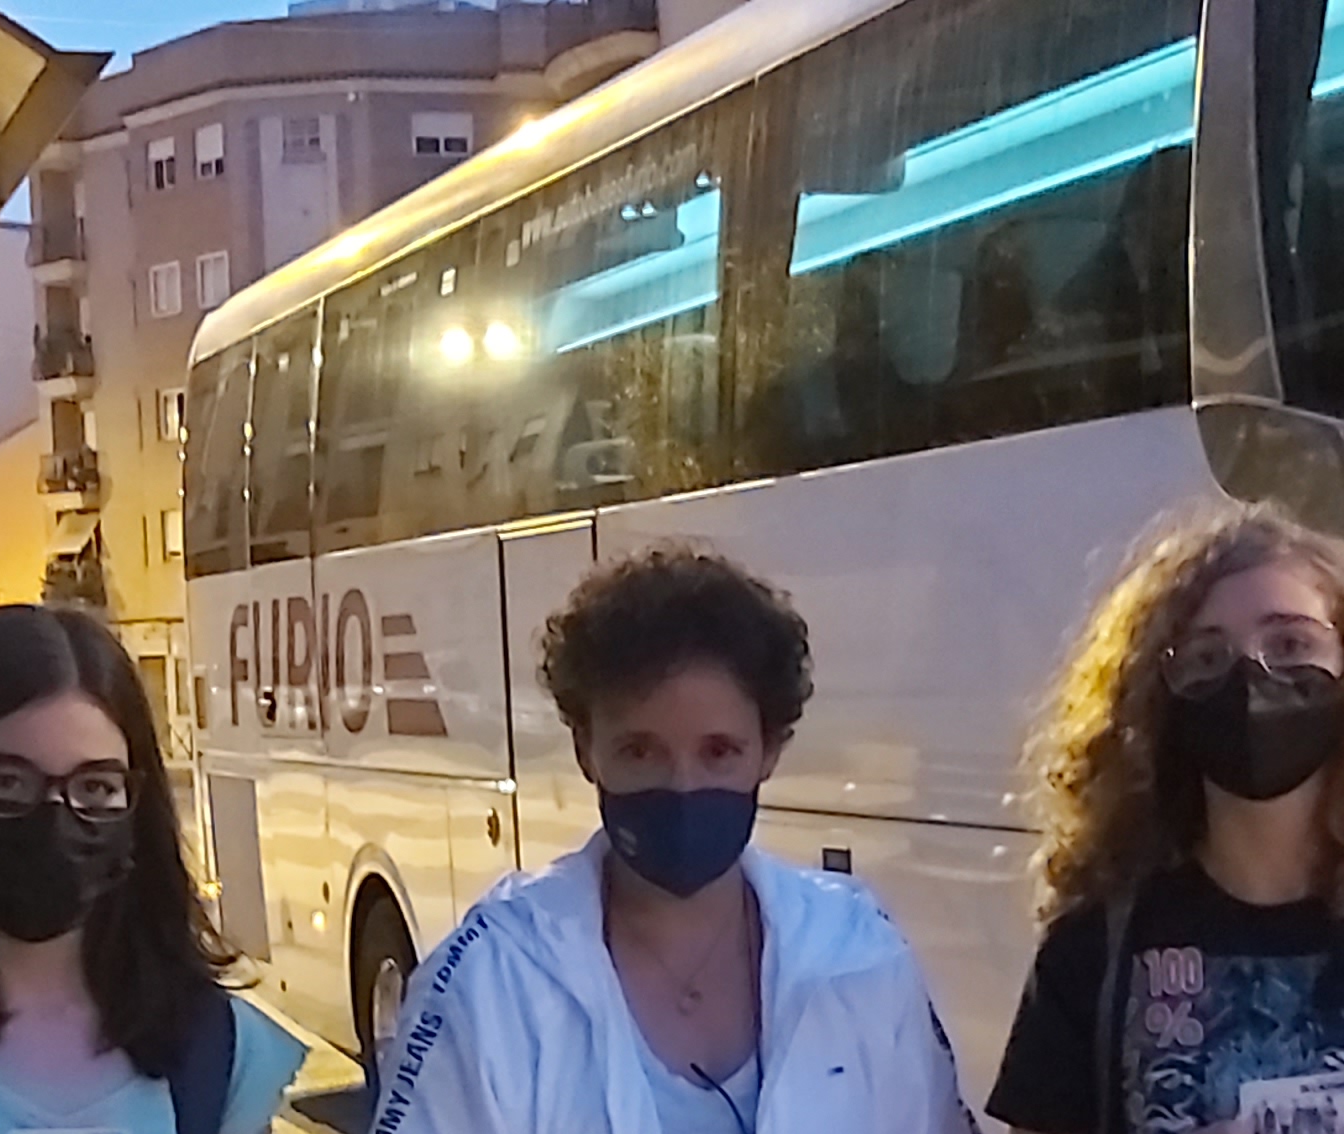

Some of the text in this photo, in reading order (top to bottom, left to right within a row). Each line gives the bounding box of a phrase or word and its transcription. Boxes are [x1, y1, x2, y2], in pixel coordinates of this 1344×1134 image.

[1142, 946, 1204, 998] 100
[396, 1010, 444, 1090] JEANS
[1144, 1000, 1204, 1048] %
